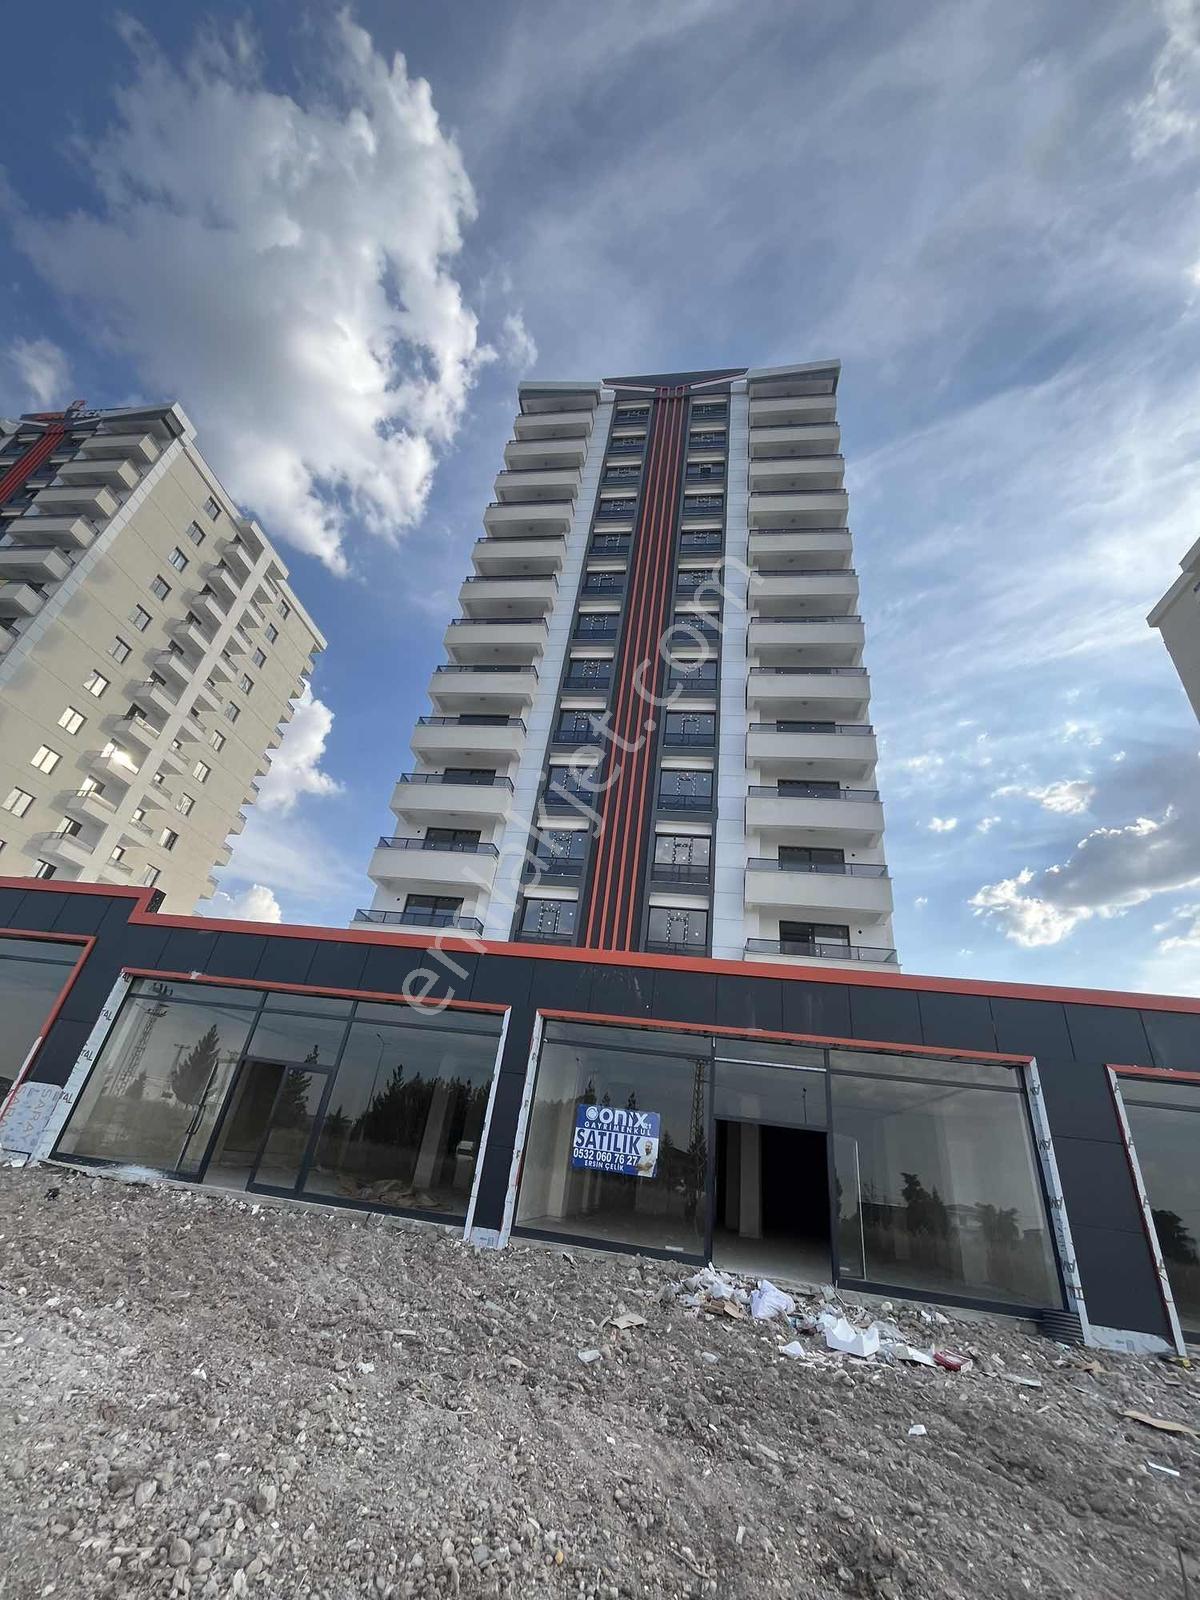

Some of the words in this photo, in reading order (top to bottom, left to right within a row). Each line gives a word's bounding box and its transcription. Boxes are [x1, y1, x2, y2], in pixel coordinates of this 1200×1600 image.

[575, 1128, 640, 1155] SATILIK
[573, 1148, 594, 1160] 0532
[596, 1151, 612, 1162] 060
[614, 1154, 624, 1164] 76
[626, 1156, 638, 1166] 27
